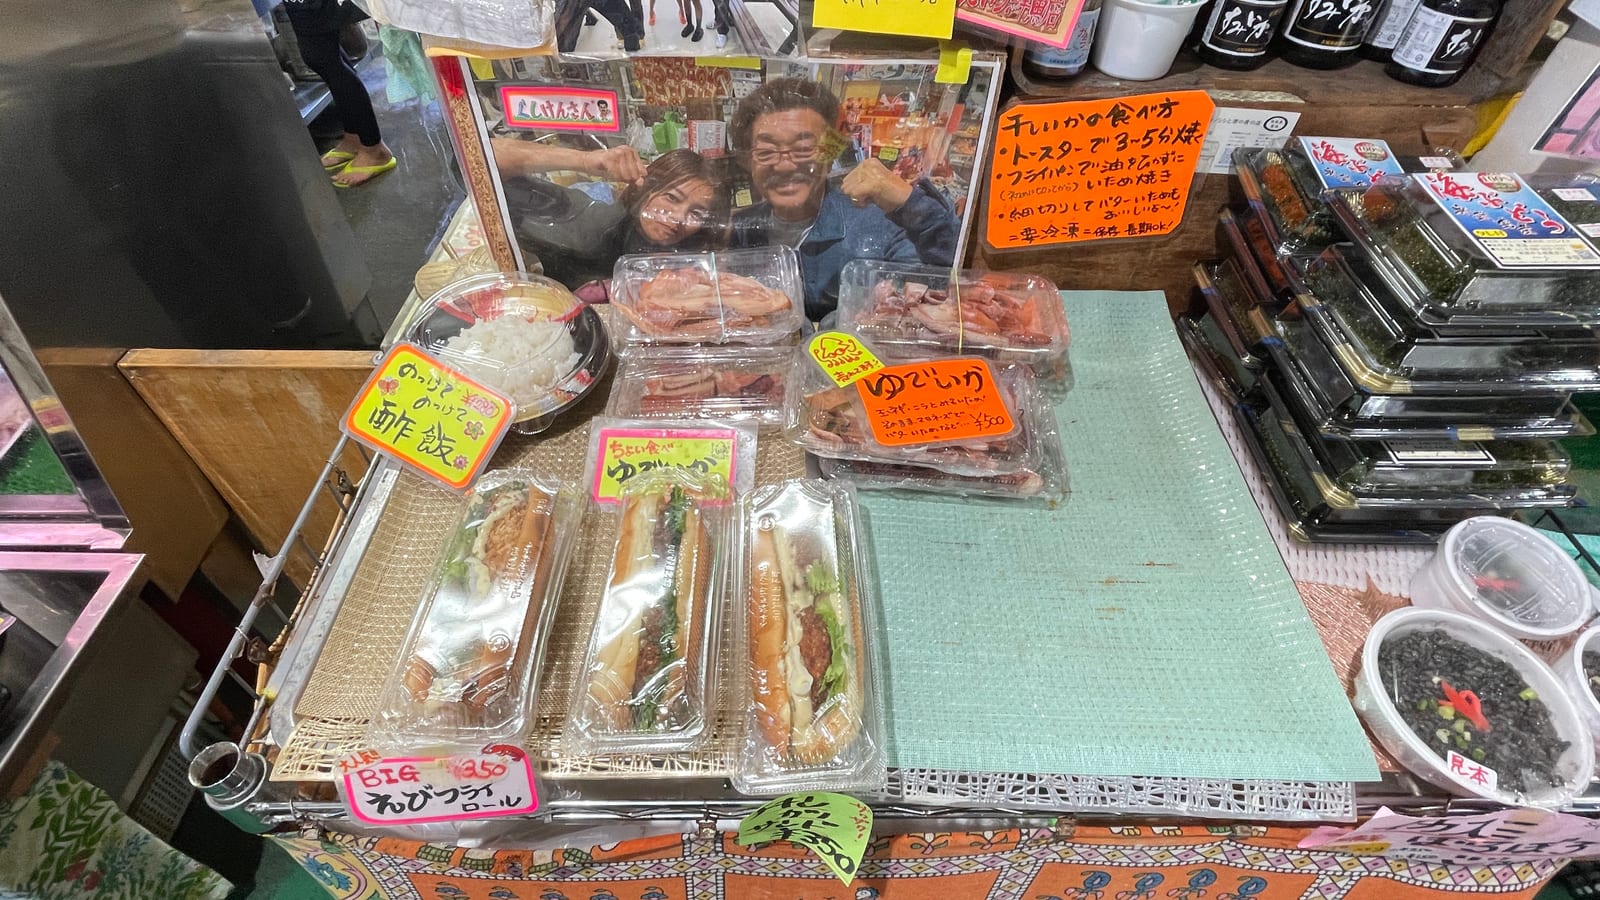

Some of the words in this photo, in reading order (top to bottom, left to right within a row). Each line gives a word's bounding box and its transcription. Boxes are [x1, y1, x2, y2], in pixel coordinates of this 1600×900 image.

[1001, 97, 1180, 137] 干しいかの食べ方
[1425, 172, 1566, 235] 海ぶどう
[398, 362, 455, 399] のっけて
[863, 366, 984, 401] ゆでいか
[413, 395, 468, 423] のっけて
[970, 412, 1005, 432] ¥500
[609, 440, 674, 459] ちょい食べ
[357, 764, 421, 788] BIG
[1451, 754, 1490, 786] 見本
[364, 783, 494, 816] えびフライ
[461, 795, 522, 812] ロール
